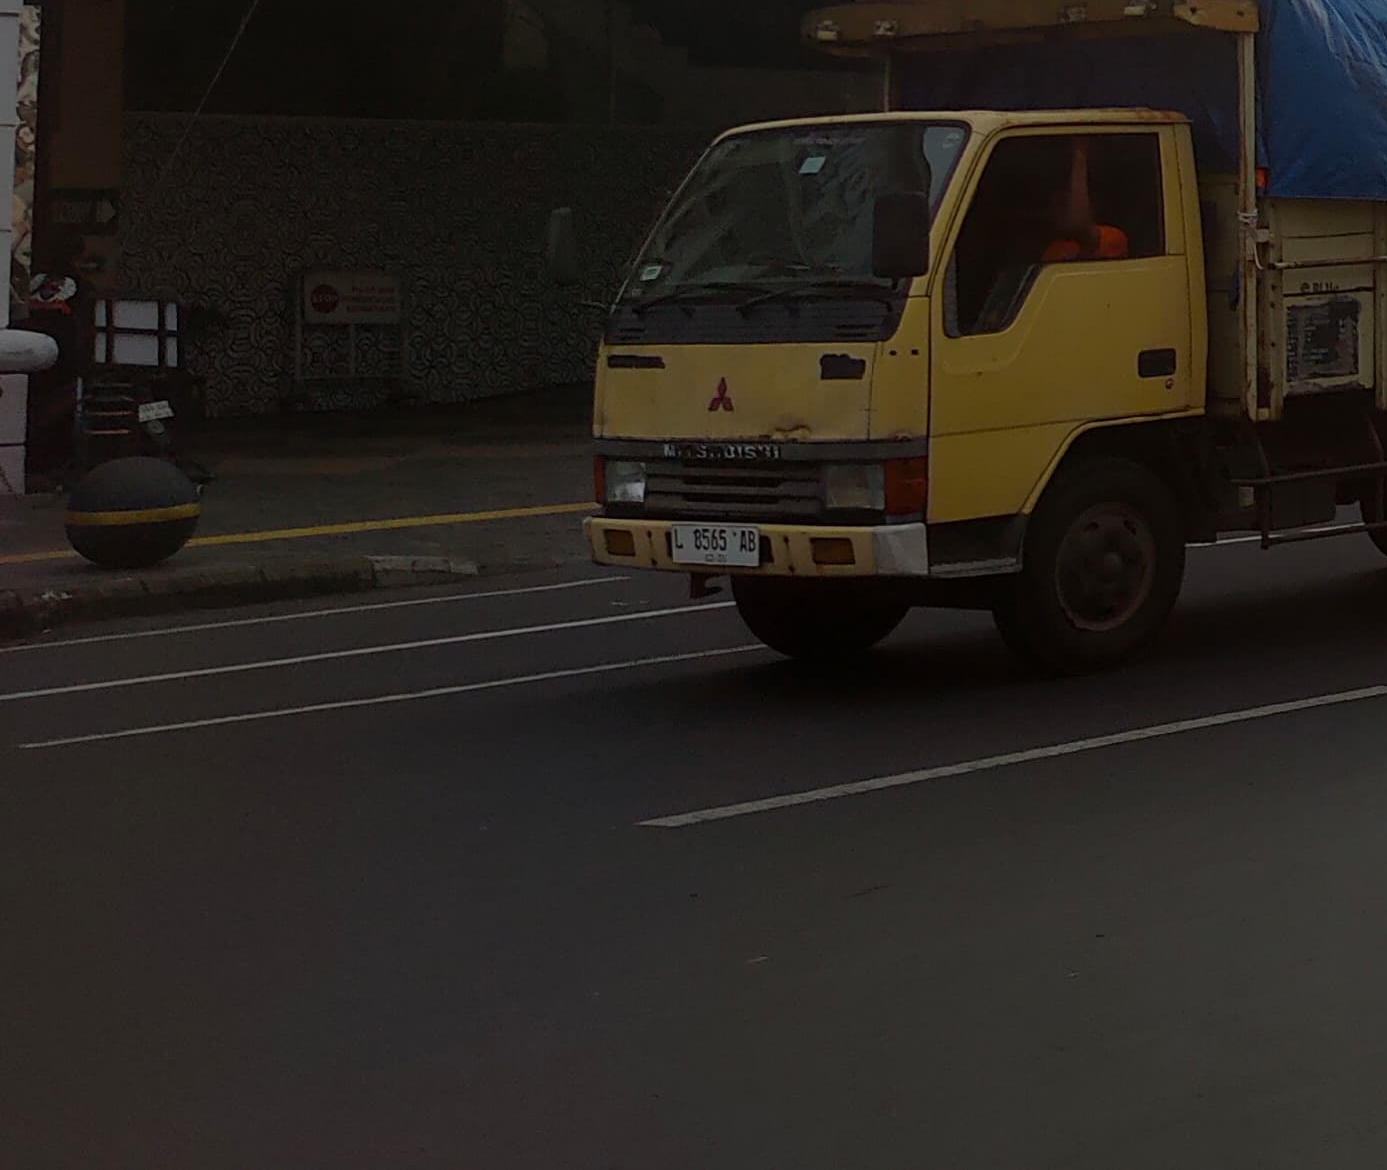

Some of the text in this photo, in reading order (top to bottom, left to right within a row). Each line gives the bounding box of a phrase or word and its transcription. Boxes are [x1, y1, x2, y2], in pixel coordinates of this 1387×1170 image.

[674, 529, 756, 553] L 8565 AB
